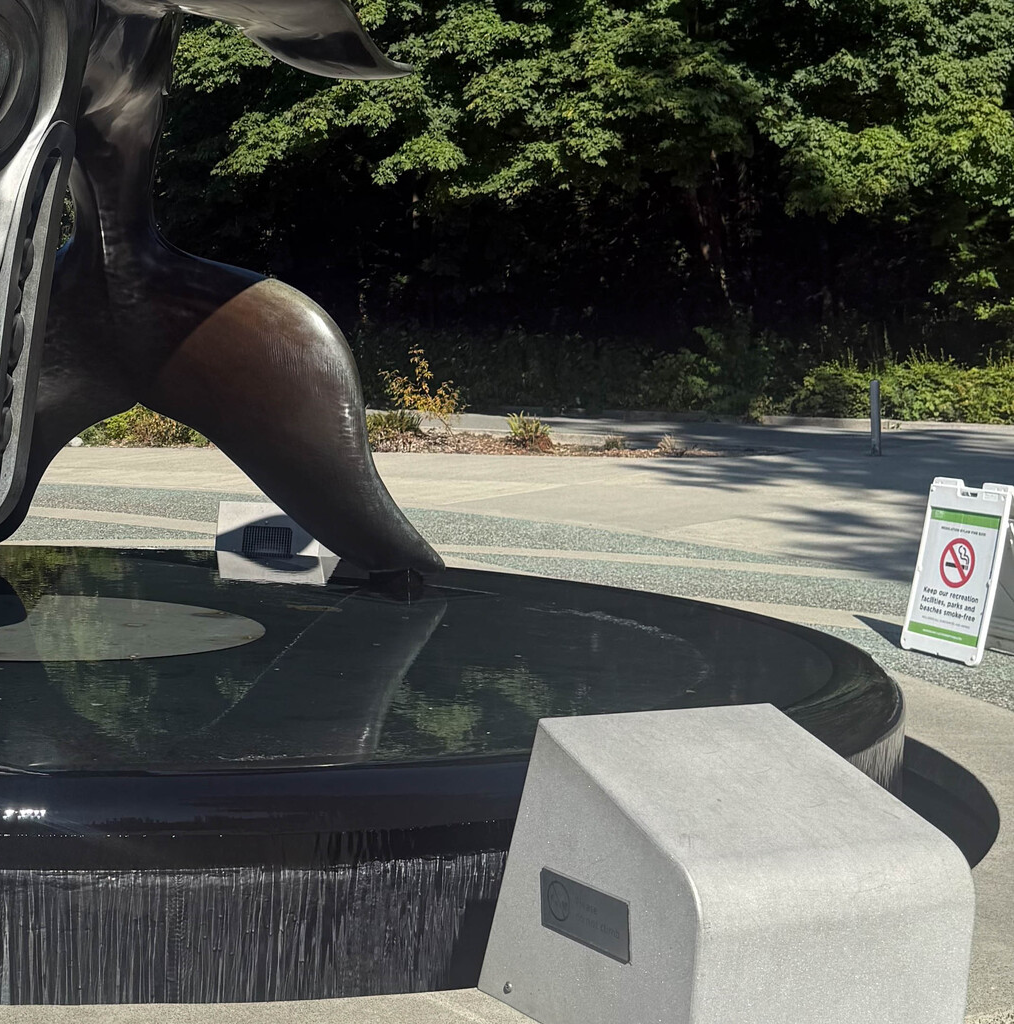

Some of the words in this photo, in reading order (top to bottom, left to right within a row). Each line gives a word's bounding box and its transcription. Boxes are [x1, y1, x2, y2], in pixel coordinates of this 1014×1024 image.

[923, 586, 937, 595] Keep
[950, 592, 978, 603] recreation
[921, 595, 945, 607] facilities,
[947, 601, 963, 610] parks
[964, 605, 975, 613] and
[920, 604, 942, 615] beaches
[944, 610, 975, 622] smoke-free
[600, 923, 620, 939] climb
